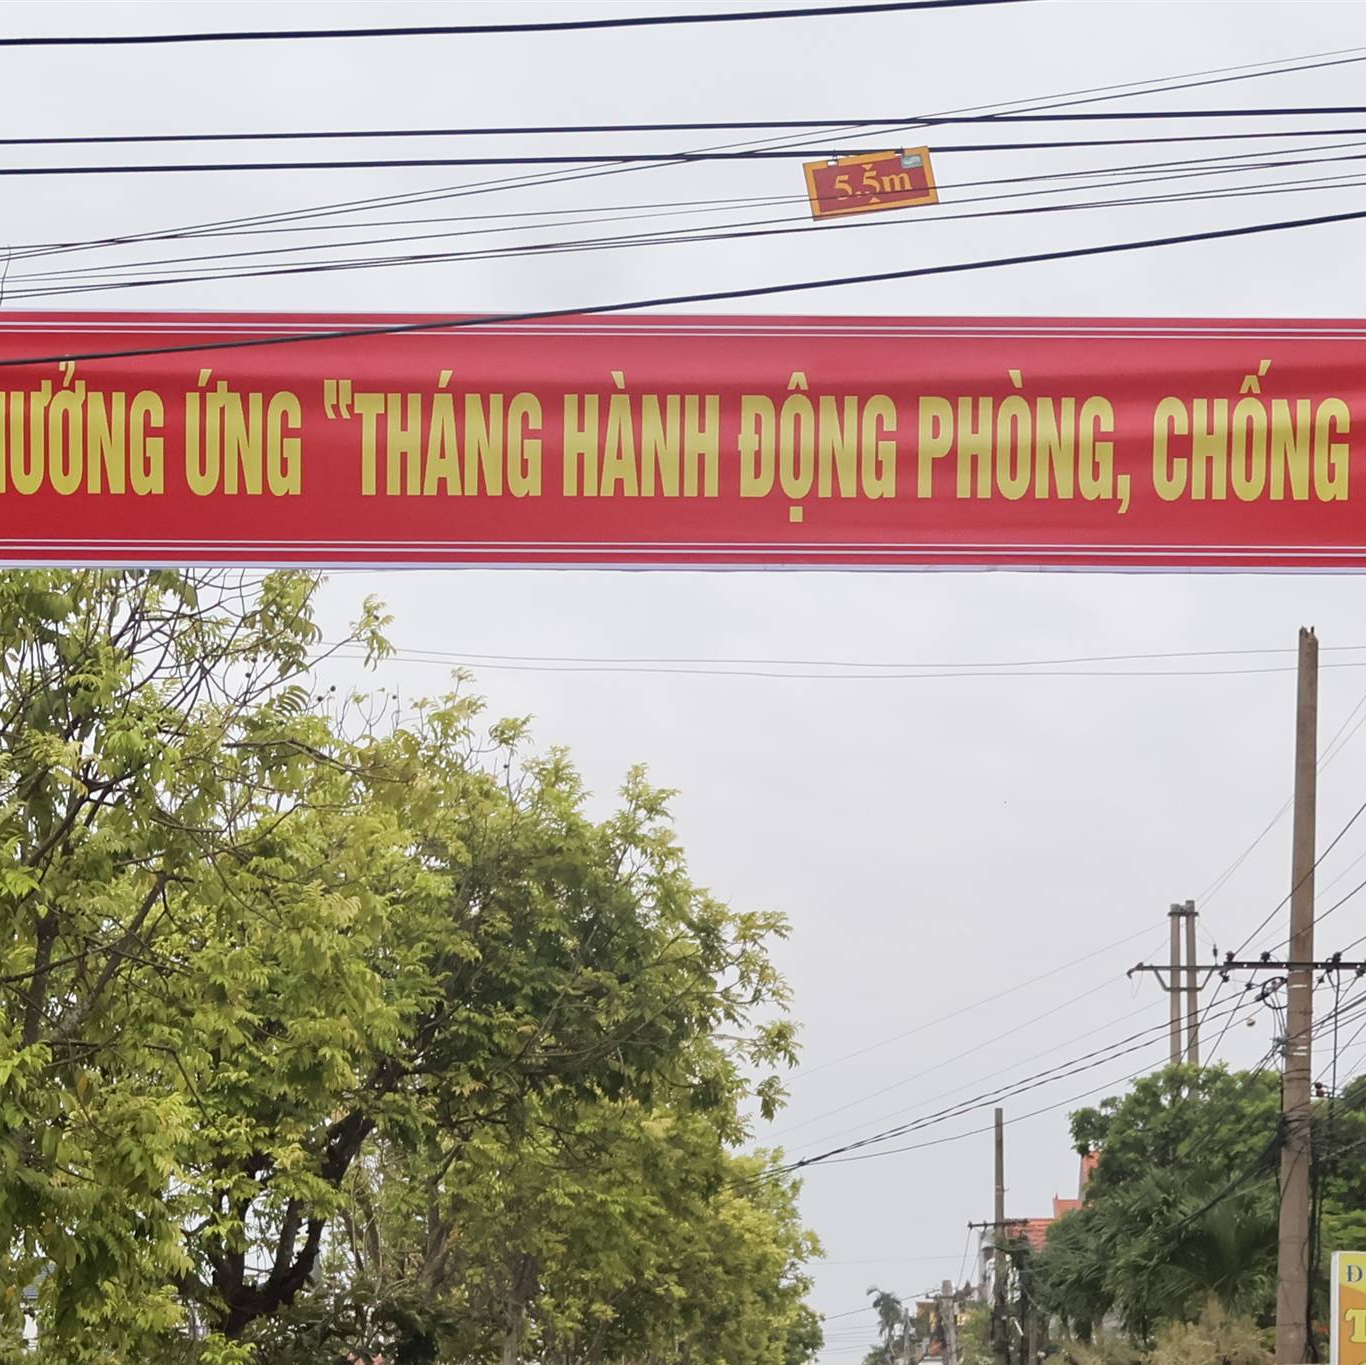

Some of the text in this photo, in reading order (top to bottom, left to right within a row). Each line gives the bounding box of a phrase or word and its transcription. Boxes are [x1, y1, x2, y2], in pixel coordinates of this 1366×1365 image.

[185, 368, 302, 497] ỨNG
[562, 371, 720, 497] HÀNH
[738, 372, 898, 523] ĐỘNG
[917, 369, 1131, 513] PHÒNG,
[1152, 359, 1351, 503] CHỐNG
